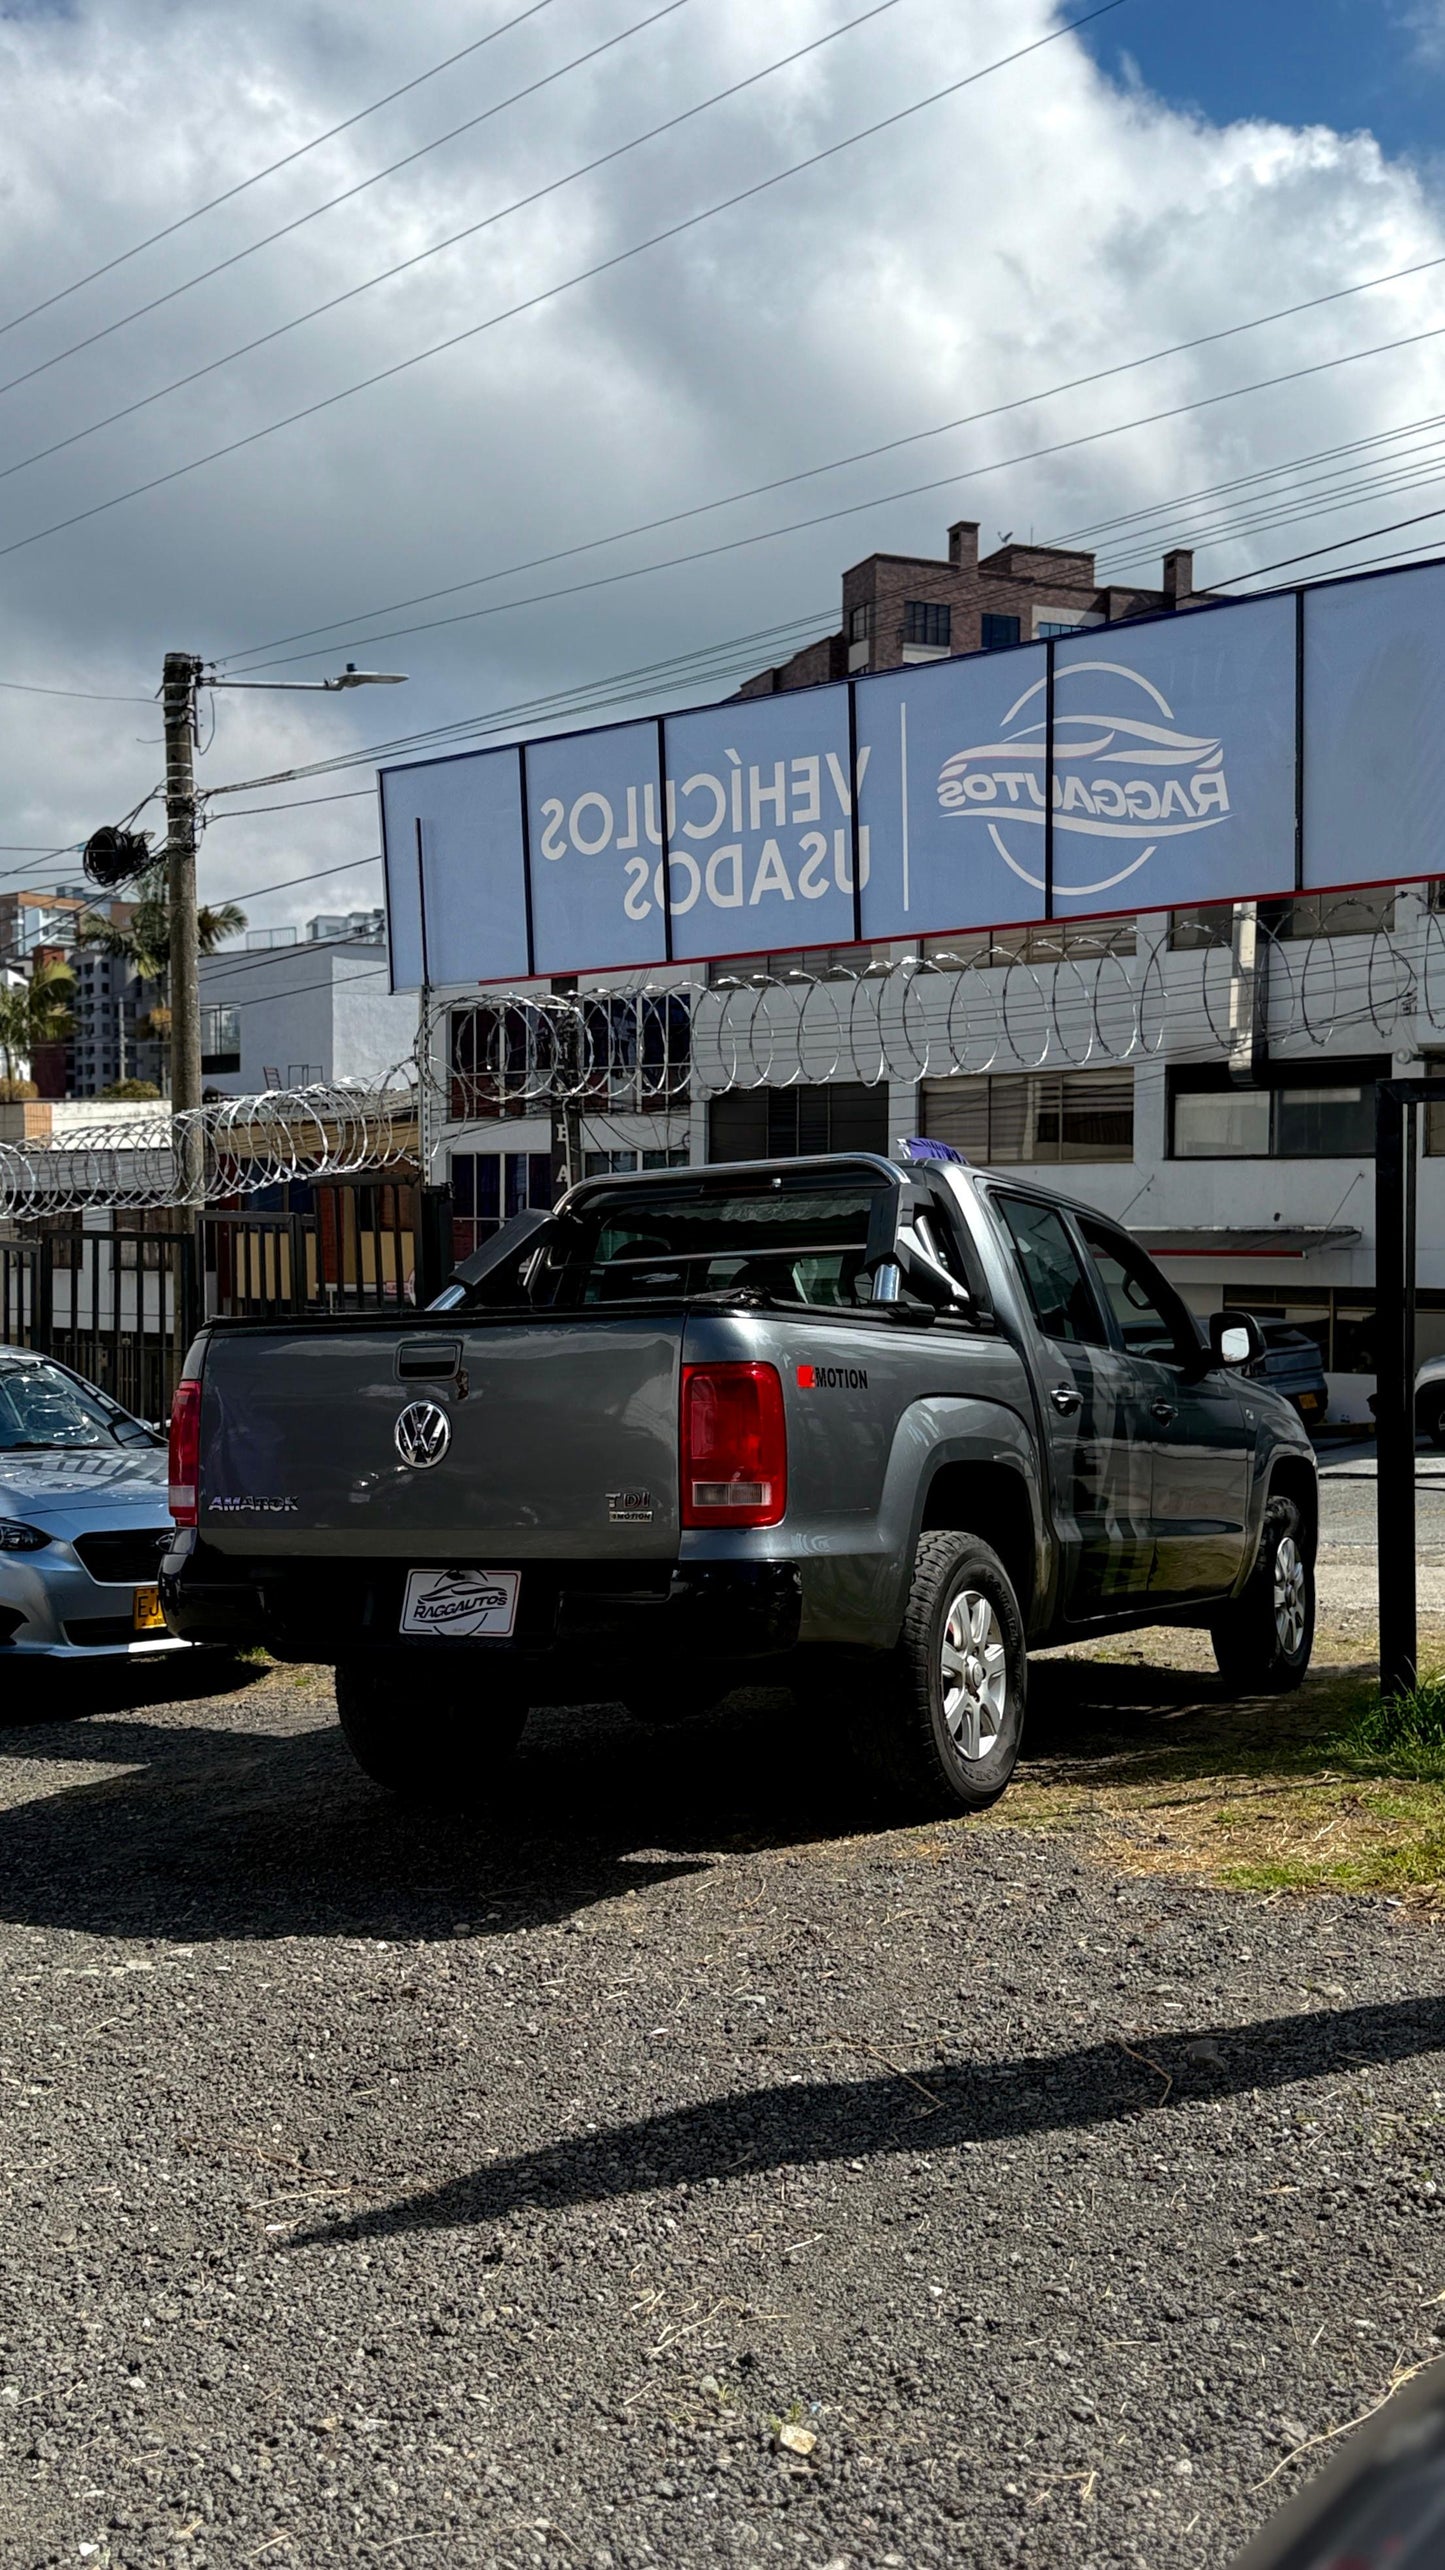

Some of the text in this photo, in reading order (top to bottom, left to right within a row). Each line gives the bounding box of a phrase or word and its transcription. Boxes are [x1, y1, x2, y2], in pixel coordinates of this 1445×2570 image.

[208, 1496, 299, 1511] AMAROK
[605, 1492, 650, 1508] TDI
[137, 1595, 159, 1617] EJ
[413, 1595, 508, 1619] RAGGAUTOS
